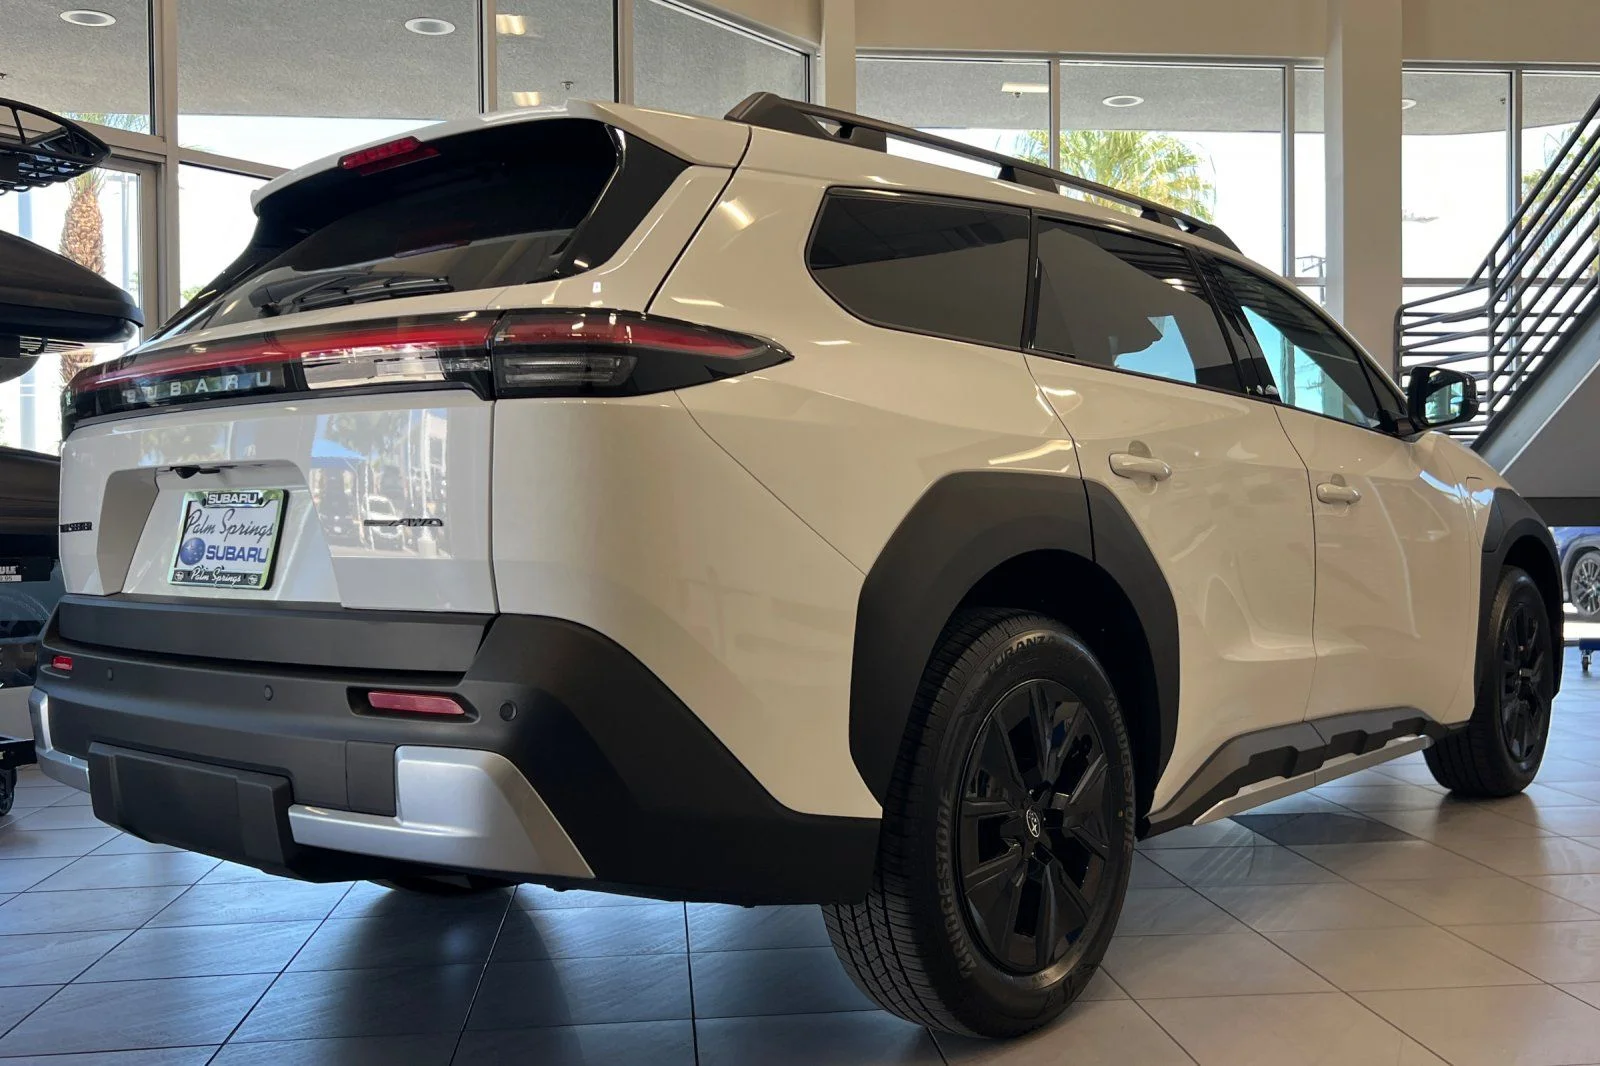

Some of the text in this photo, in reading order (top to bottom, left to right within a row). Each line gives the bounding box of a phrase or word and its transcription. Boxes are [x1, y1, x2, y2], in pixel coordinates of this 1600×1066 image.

[122, 371, 271, 404] SUBARU
[208, 493, 257, 504] SUBARU
[185, 508, 274, 543] Palm Springs
[205, 545, 269, 563] SUBARU
[191, 566, 242, 585] Palm Springs
